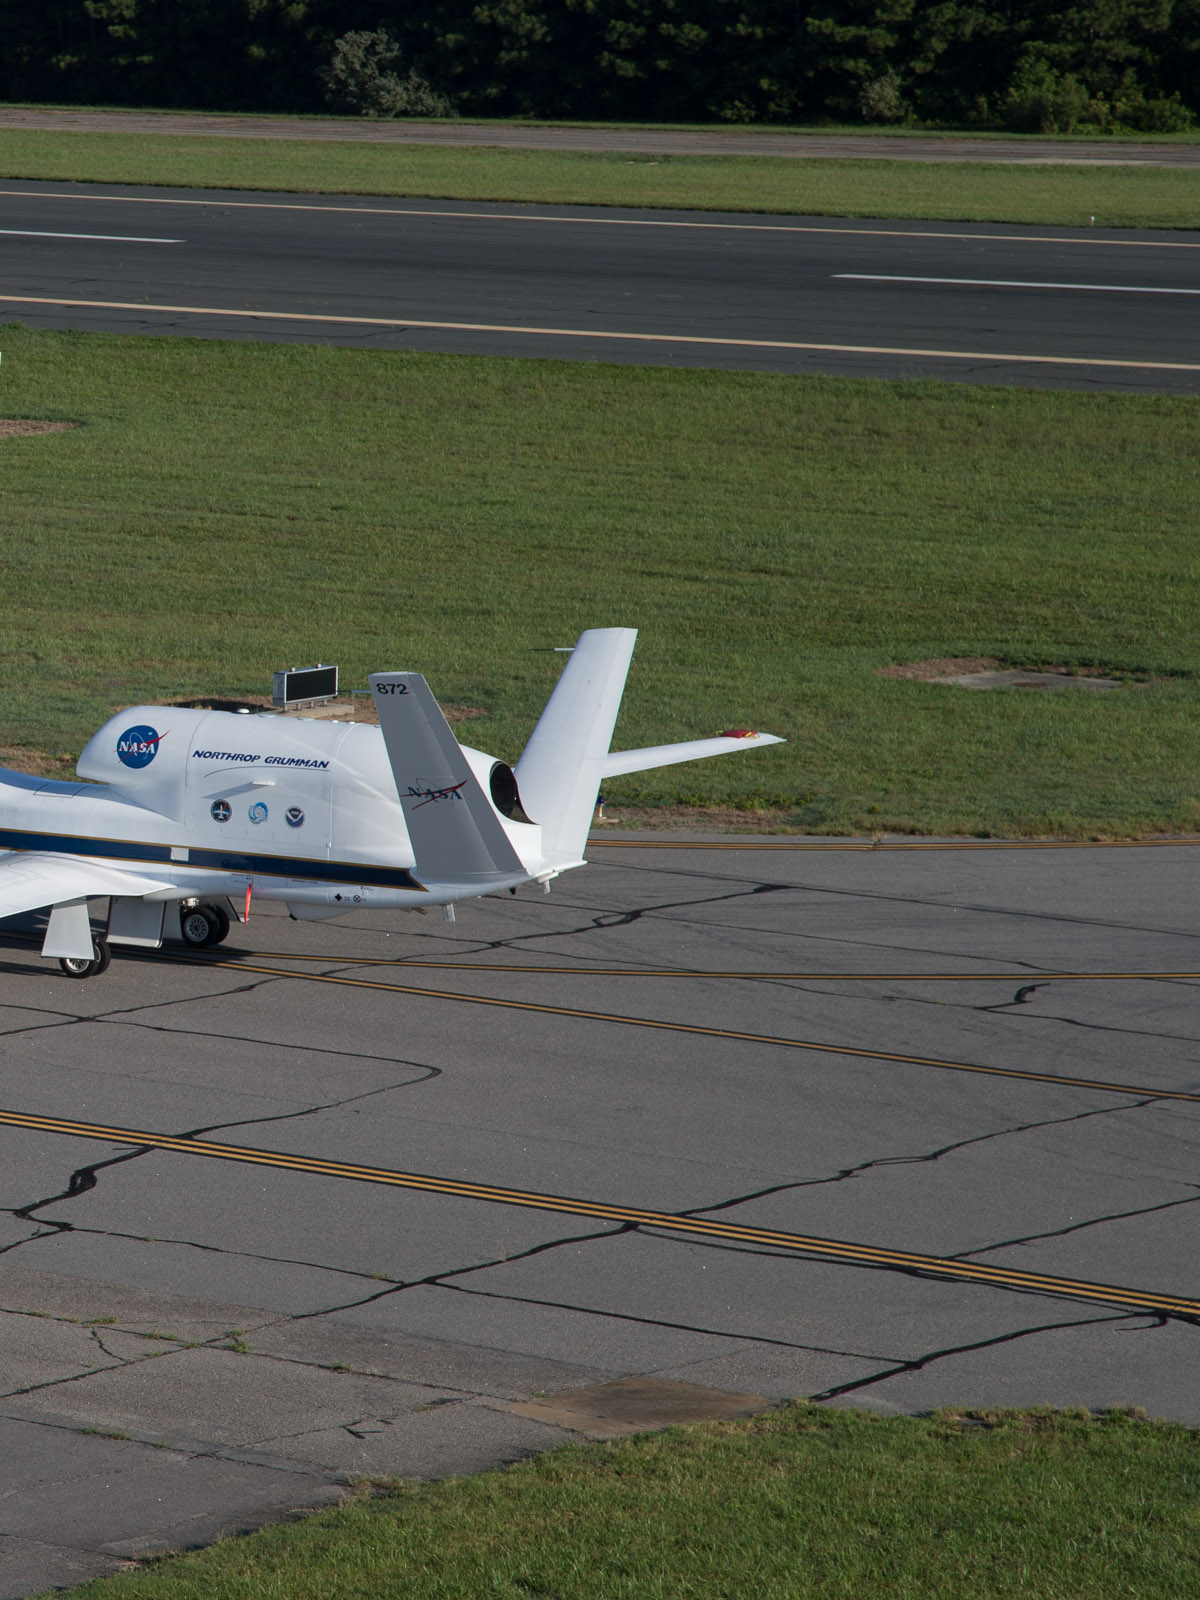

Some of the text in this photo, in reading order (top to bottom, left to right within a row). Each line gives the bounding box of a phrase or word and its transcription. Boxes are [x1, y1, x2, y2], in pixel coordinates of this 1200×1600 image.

[376, 683, 410, 695] 872
[119, 741, 155, 754] NASA
[192, 750, 329, 768] NORTHROP GRUMMAN
[407, 786, 462, 801] NASA
